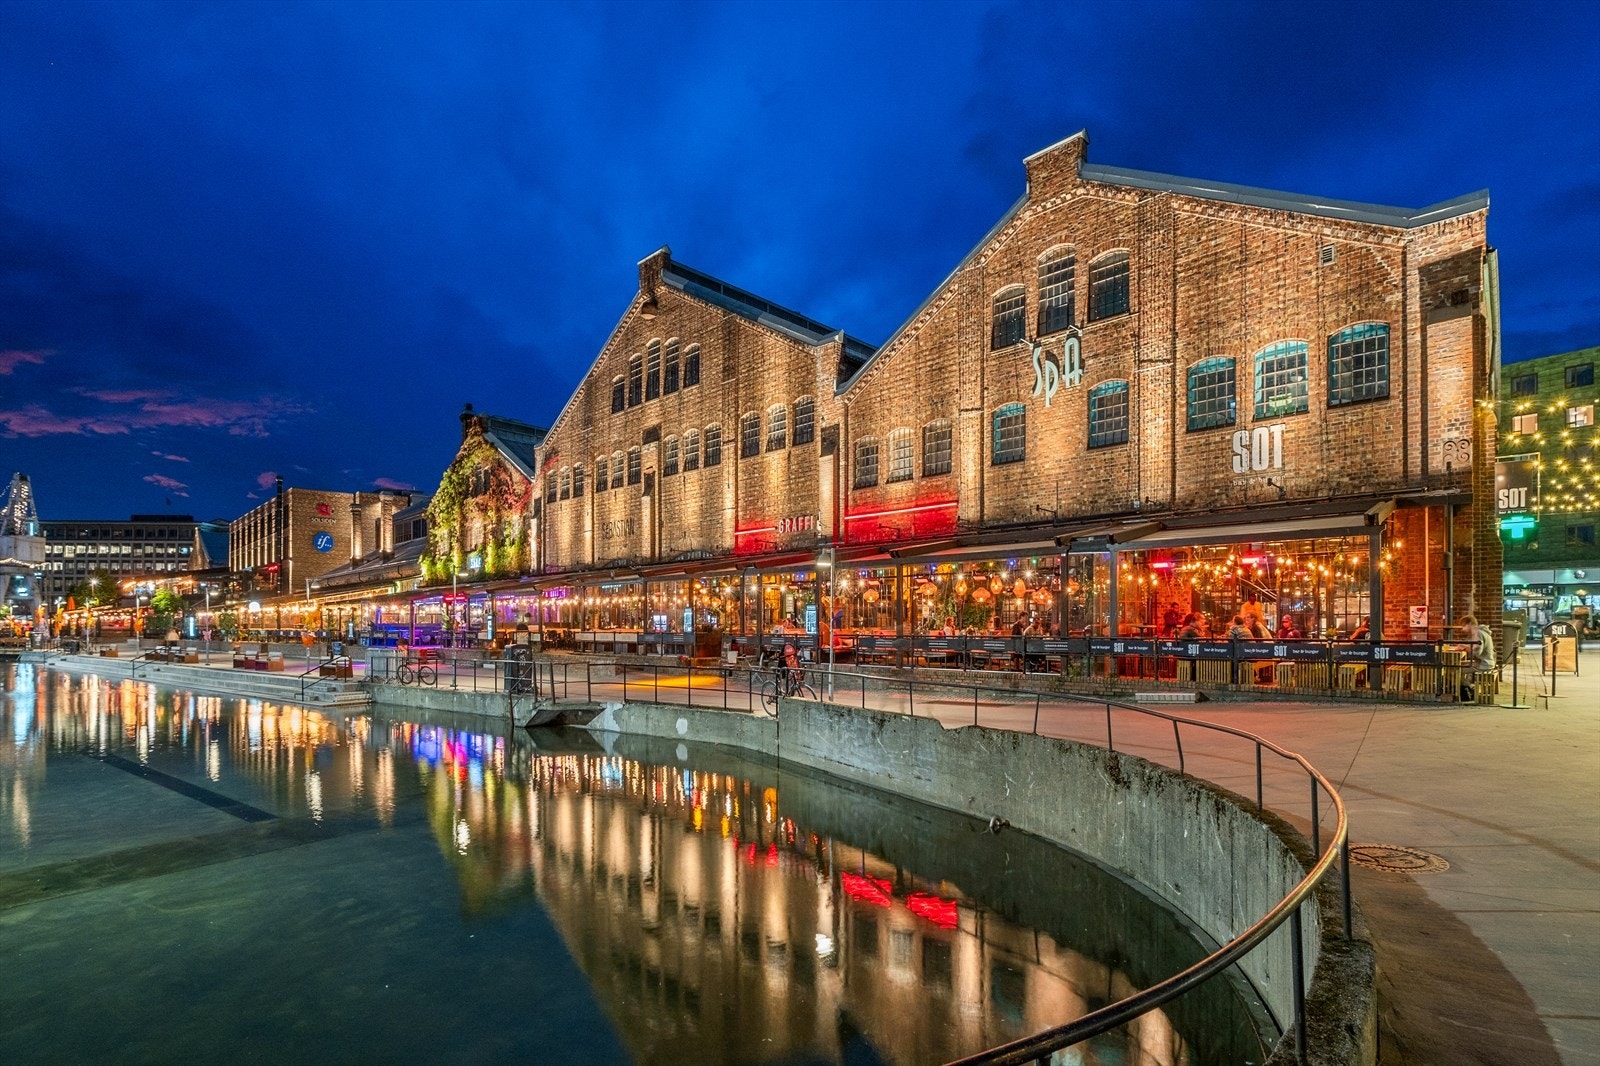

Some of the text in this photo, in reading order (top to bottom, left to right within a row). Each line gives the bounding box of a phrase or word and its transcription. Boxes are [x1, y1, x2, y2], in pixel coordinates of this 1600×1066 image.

[1232, 424, 1286, 474] SOT
[1258, 475, 1287, 483] buger
[1498, 487, 1528, 508] SOT
[778, 515, 814, 534] GRAFFI
[1551, 625, 1567, 635] SOT
[1113, 642, 1125, 653] SOT
[1188, 644, 1200, 655] SOT
[1274, 645, 1288, 657] SOT
[1375, 647, 1390, 659] SOT
